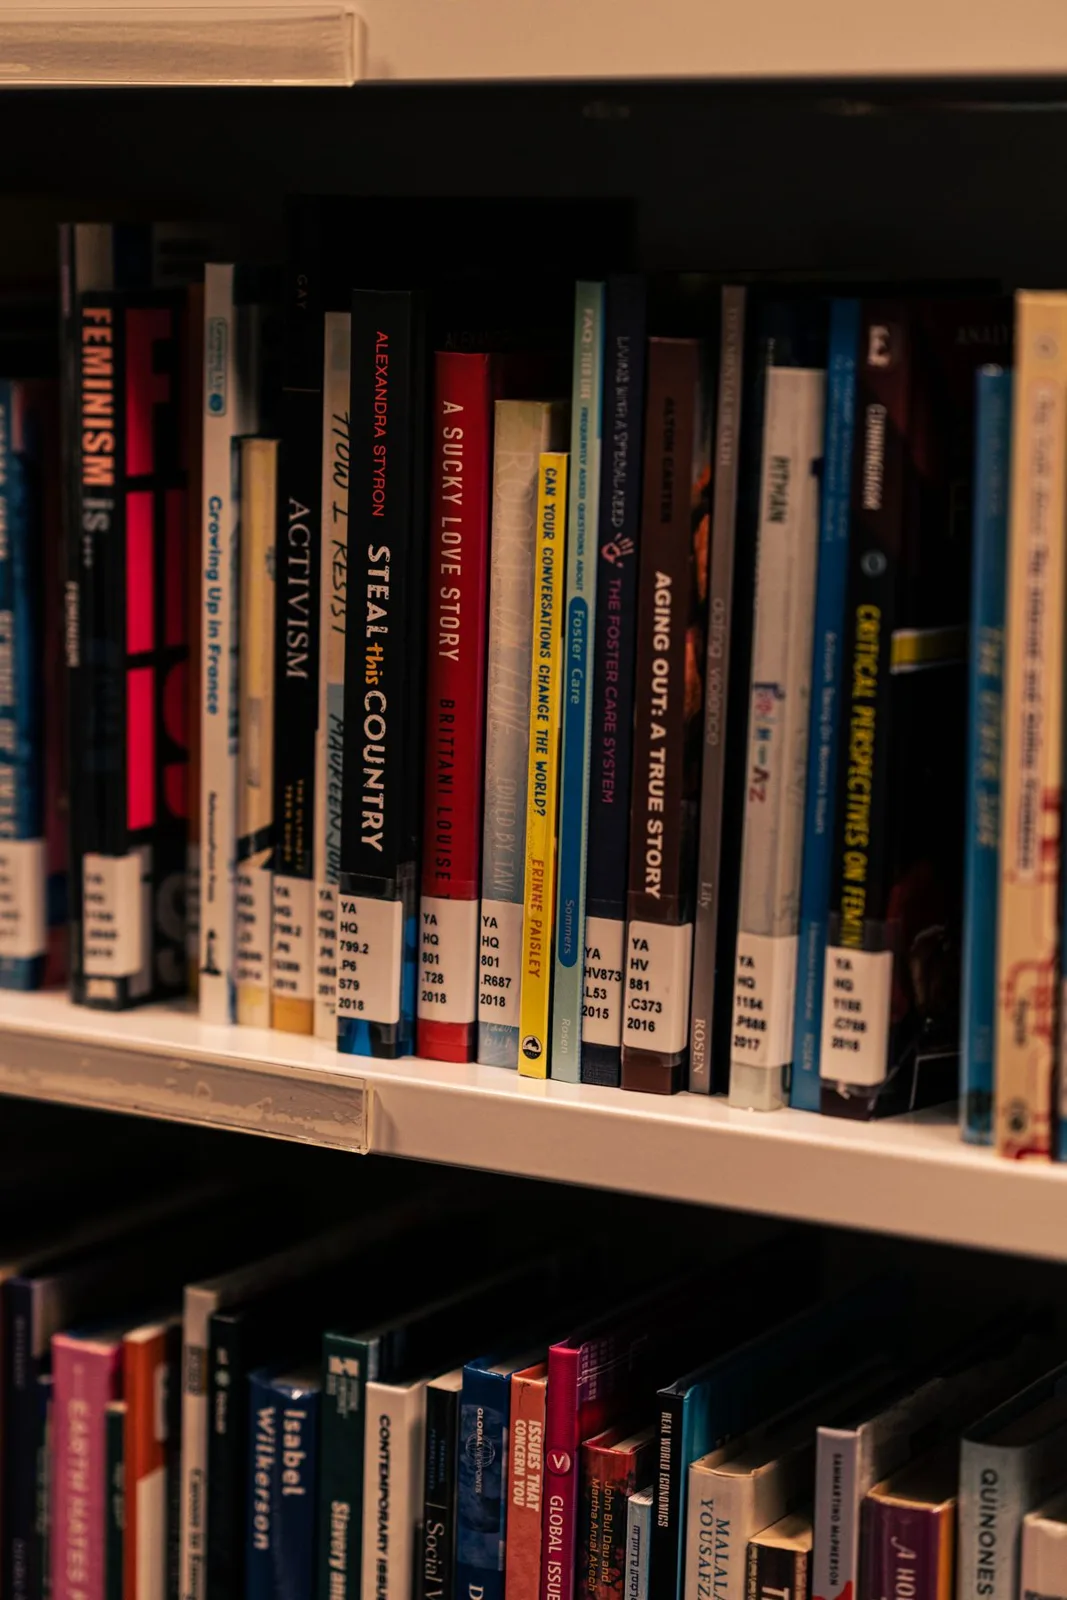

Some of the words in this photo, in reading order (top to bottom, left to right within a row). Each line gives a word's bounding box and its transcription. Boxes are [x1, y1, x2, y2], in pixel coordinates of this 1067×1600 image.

[81, 307, 116, 487] FEMINISM
[374, 330, 391, 440] ALEXANDRA
[442, 400, 464, 415] A
[577, 407, 588, 466] FREQUENTLY
[371, 444, 388, 517] STYRON
[441, 427, 464, 507] SUCKY
[545, 467, 559, 498] CAN
[577, 469, 587, 499] ASKED
[206, 496, 222, 580] Growing
[543, 505, 557, 540] YOUR
[576, 503, 587, 556] QUESTIONS
[439, 516, 463, 584] LOVE
[286, 498, 312, 680] ACTIVISM
[366, 543, 392, 639] STEAL
[575, 560, 585, 592] ABOUT
[608, 578, 621, 610] THE
[207, 586, 221, 614] Up
[538, 547, 554, 659] CONVERSATIONS
[654, 571, 673, 653] AGING
[208, 620, 221, 637] in
[437, 590, 462, 662] STORY
[572, 609, 584, 662] Foster
[708, 597, 724, 658] dating
[364, 642, 386, 685] this
[605, 615, 620, 682] FOSTER
[851, 604, 882, 698] CRITICAL
[207, 643, 221, 715] France
[537, 664, 551, 722] CHANGE
[570, 667, 582, 704] Care
[650, 657, 671, 718] OUT:
[603, 686, 618, 733] CARE
[437, 699, 456, 796] BRITTANI
[536, 728, 550, 756] THE
[649, 720, 667, 740] A
[361, 688, 388, 852] COUNTRY
[601, 737, 616, 804] SYSTEM
[646, 745, 667, 811] TRUE
[844, 704, 876, 846] PERSPECTIVES
[533, 761, 549, 817] WORLD?
[434, 806, 453, 881] LOUISE
[644, 816, 663, 899] STORY
[841, 851, 866, 882] ON
[531, 858, 546, 914] ERINNE
[699, 881, 713, 912] Lily
[341, 902, 357, 915] YA
[422, 913, 438, 926] YA
[482, 915, 498, 929] YA
[563, 899, 575, 955] Sommers
[340, 921, 358, 935] HQ
[422, 932, 439, 946] HQ
[482, 935, 499, 949] HQ
[632, 938, 649, 952] YA
[339, 941, 369, 955] 799.2
[340, 959, 357, 972] .P6
[422, 951, 440, 965] 801
[481, 955, 499, 968] 801
[527, 920, 543, 980] PAISLEY
[584, 946, 601, 961] YA
[631, 957, 649, 971] HV
[739, 955, 754, 968] YA
[339, 977, 360, 991] S79
[421, 971, 444, 985] .T28
[479, 974, 512, 989] .R687
[583, 965, 622, 982] HV873
[629, 977, 650, 992] 881
[737, 976, 755, 990] HQ
[338, 997, 364, 1011] 2018
[421, 990, 446, 1005] 2018
[480, 993, 506, 1007] 2018
[582, 985, 607, 1000] .L53
[628, 997, 662, 1014] .C373
[582, 1005, 609, 1020] 2015
[627, 1016, 656, 1032] 2016
[561, 1018, 571, 1055] Rosen
[692, 1017, 706, 1074] ROSEN
[733, 1035, 760, 1052] 2017
[475, 1407, 484, 1447] GLOBAL
[661, 1411, 672, 1439] REAL
[283, 1408, 308, 1497] Isabel
[513, 1418, 527, 1480] CONCERN
[524, 1419, 542, 1470] ISSUES
[659, 1441, 671, 1477] WORLD
[253, 1407, 277, 1551] Wilkerson
[375, 1414, 391, 1554] CONTEMPORARY
[513, 1483, 525, 1507] YOU
[524, 1473, 540, 1512] THAT
[603, 1481, 615, 1510] John
[591, 1477, 601, 1519] Martha
[656, 1479, 670, 1528] ECONOMICS
[329, 1501, 350, 1571] Slavery
[548, 1495, 564, 1554] GLOBAL
[589, 1521, 599, 1552] Arual
[602, 1513, 613, 1532] Bul
[977, 1468, 998, 1596] QUINONES
[424, 1519, 446, 1585] Social
[602, 1535, 612, 1558] Dau
[698, 1499, 714, 1600] YOUSAFZ
[890, 1536, 917, 1561] A
[601, 1560, 611, 1583] and
